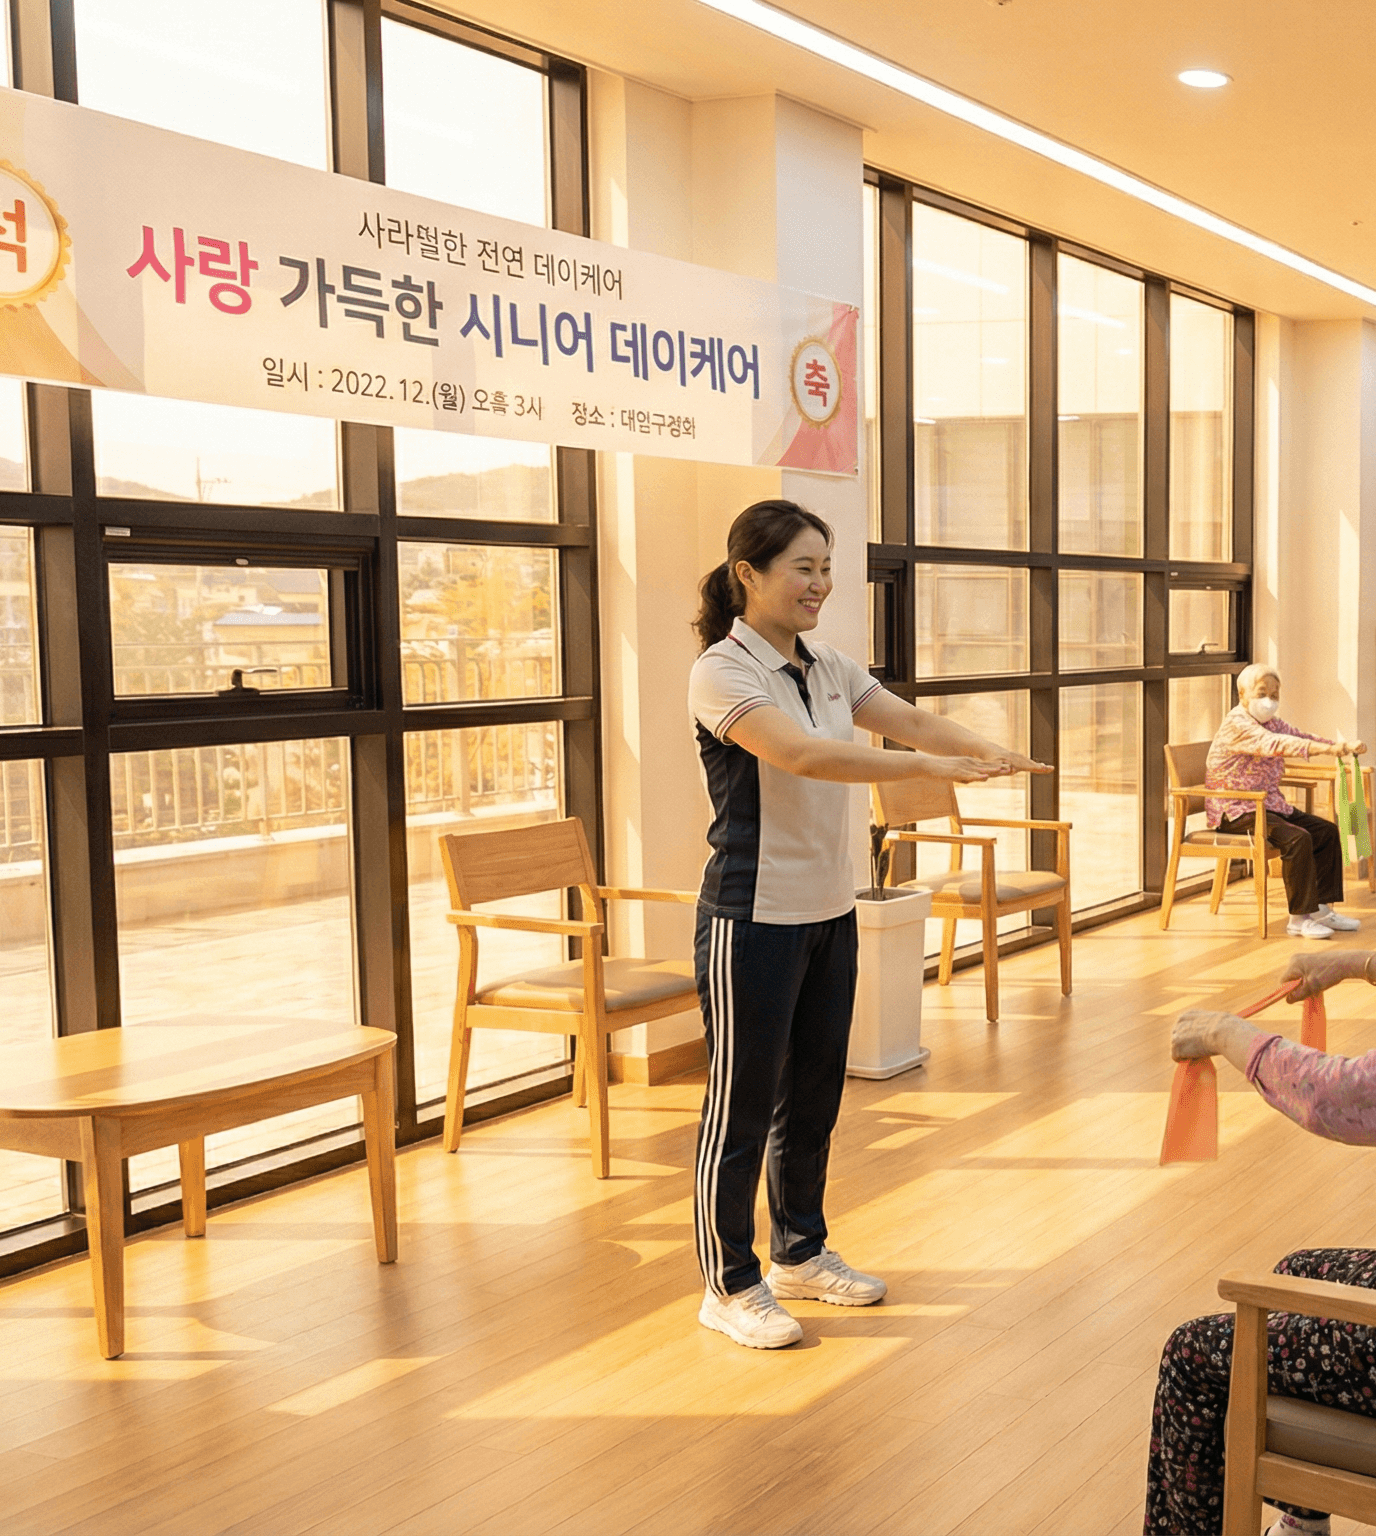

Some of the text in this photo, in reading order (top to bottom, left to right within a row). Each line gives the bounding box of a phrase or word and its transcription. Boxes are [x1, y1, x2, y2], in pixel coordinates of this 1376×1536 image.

[476, 238, 525, 279] 전연
[533, 253, 623, 300] 데이케어
[126, 225, 760, 399] 사랑 가득한 시니어 데이케어
[262, 357, 309, 392] 일시
[514, 395, 543, 421] 3시
[571, 402, 606, 426] 장소
[803, 358, 831, 407] 축
